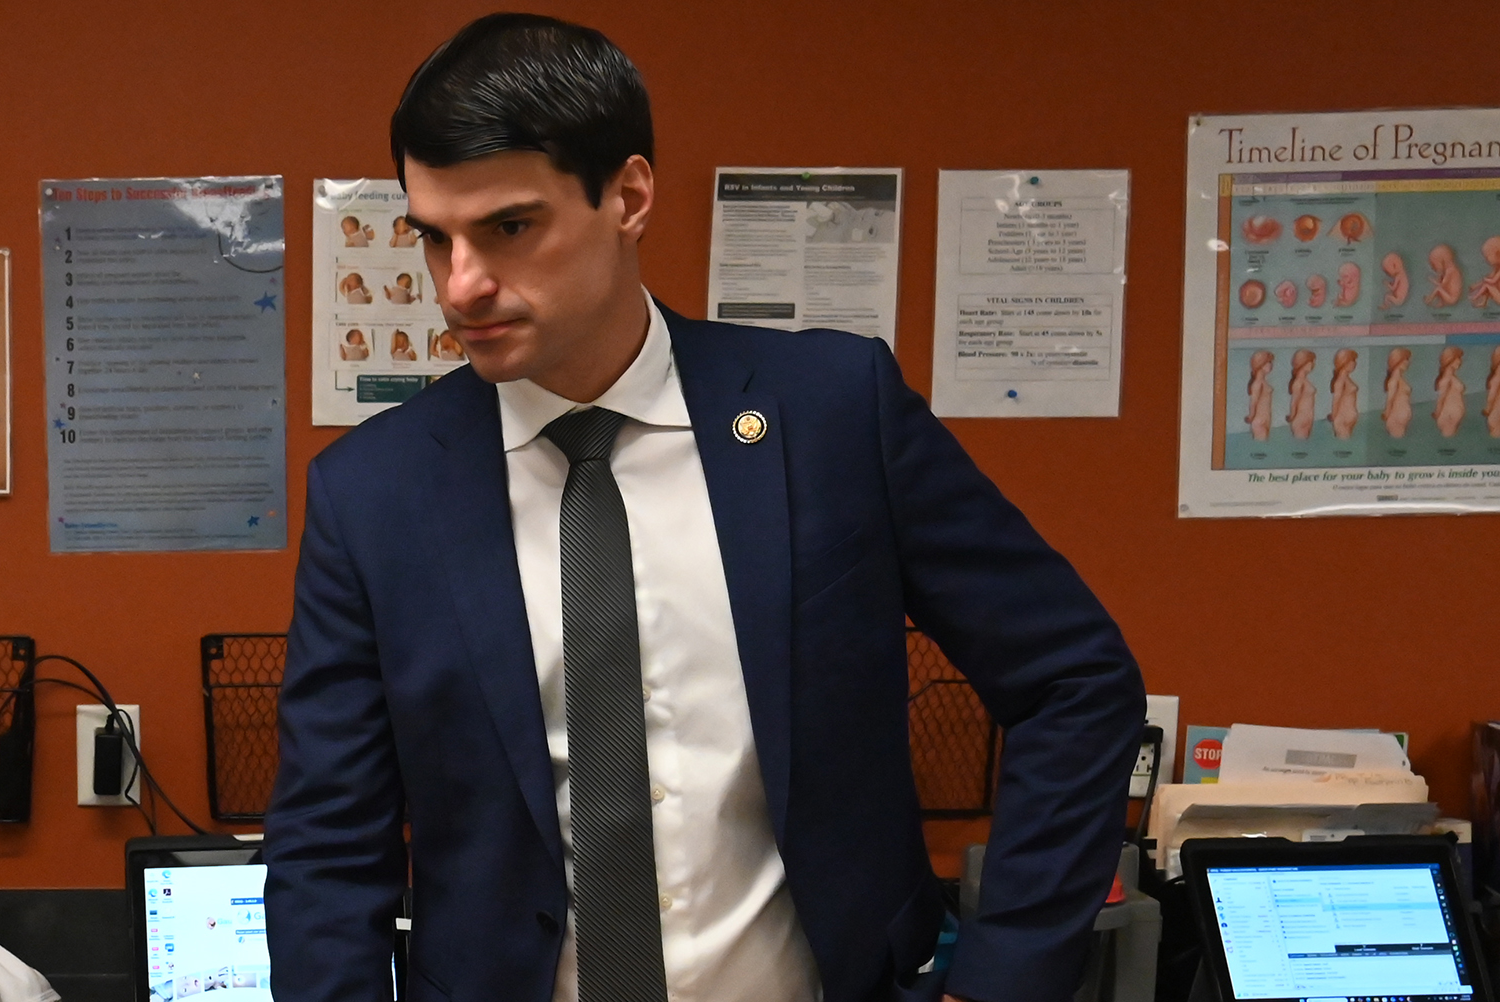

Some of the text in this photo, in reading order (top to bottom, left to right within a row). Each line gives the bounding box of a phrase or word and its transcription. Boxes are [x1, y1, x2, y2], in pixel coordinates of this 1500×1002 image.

[1219, 127, 1343, 164] Timeline
[1353, 125, 1385, 161] of
[796, 184, 820, 193] Young
[822, 184, 855, 192] Children
[53, 187, 72, 201] Ten
[76, 187, 107, 204] Steps
[111, 187, 123, 200] to
[355, 191, 389, 202] feeding
[65, 227, 71, 240] 1
[65, 250, 73, 264] 2
[65, 273, 73, 286] 3
[65, 296, 74, 309] 4
[66, 317, 74, 331] 5
[66, 338, 74, 351] 6
[66, 361, 74, 374] 7
[67, 384, 75, 397] 8
[67, 407, 75, 420] 9
[60, 430, 76, 443] 10
[1248, 474, 1266, 483] The
[1268, 473, 1289, 482] best
[1292, 472, 1319, 484] place
[1322, 471, 1338, 481] for
[1341, 473, 1364, 482] your
[1367, 471, 1390, 482] baby
[1394, 471, 1405, 480] to
[1408, 471, 1434, 482] grow
[1437, 470, 1445, 479] is
[1448, 469, 1479, 479] inside
